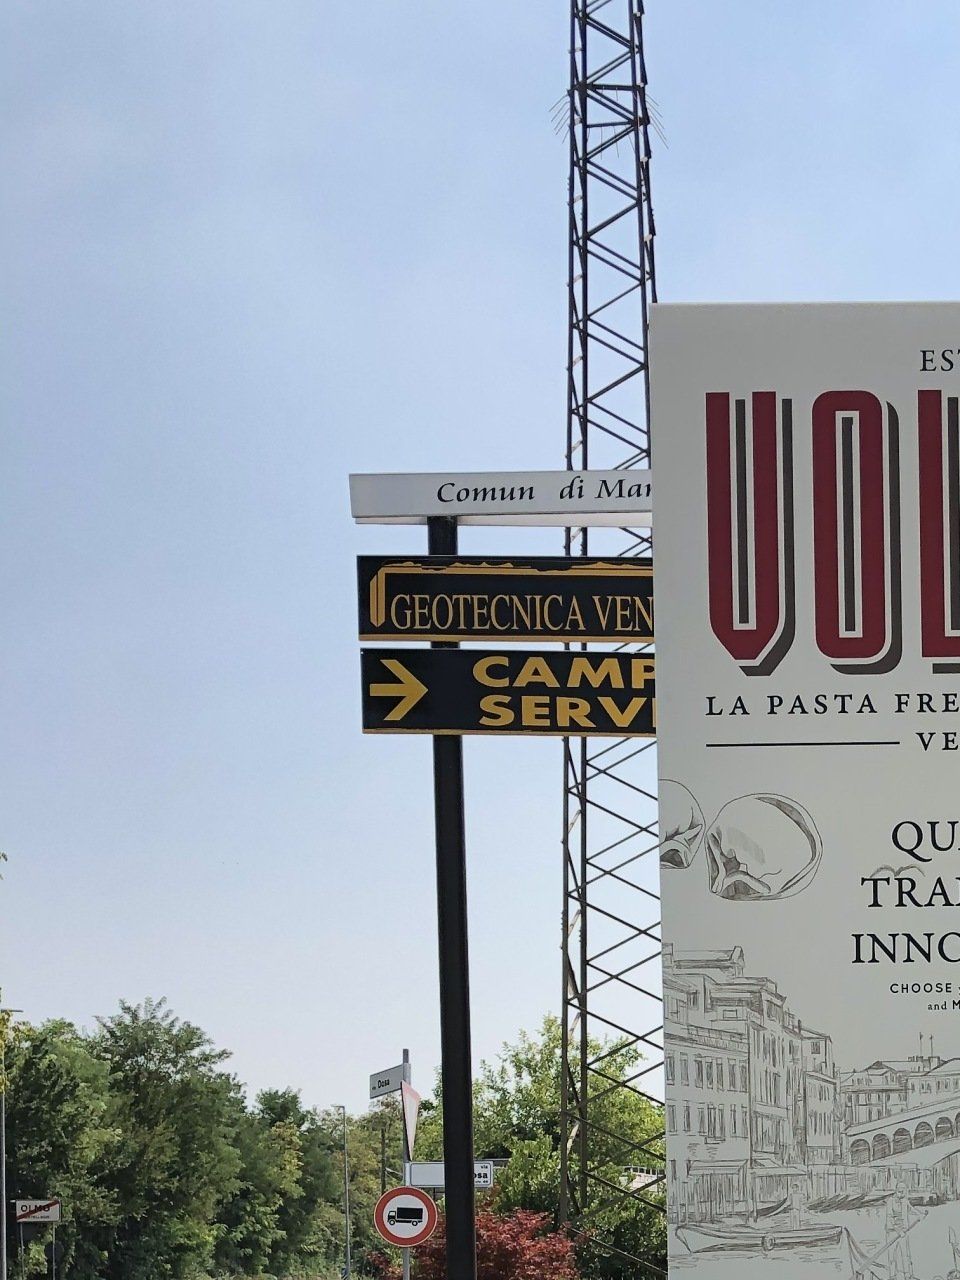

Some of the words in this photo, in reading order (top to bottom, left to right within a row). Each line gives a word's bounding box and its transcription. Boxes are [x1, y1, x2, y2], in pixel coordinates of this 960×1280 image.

[559, 476, 585, 500] di
[390, 594, 585, 631] GEOTECNICA
[704, 695, 751, 716] LA
[766, 693, 878, 715] PASTA
[889, 982, 953, 994] CHOOSE
[927, 1000, 948, 1011] and
